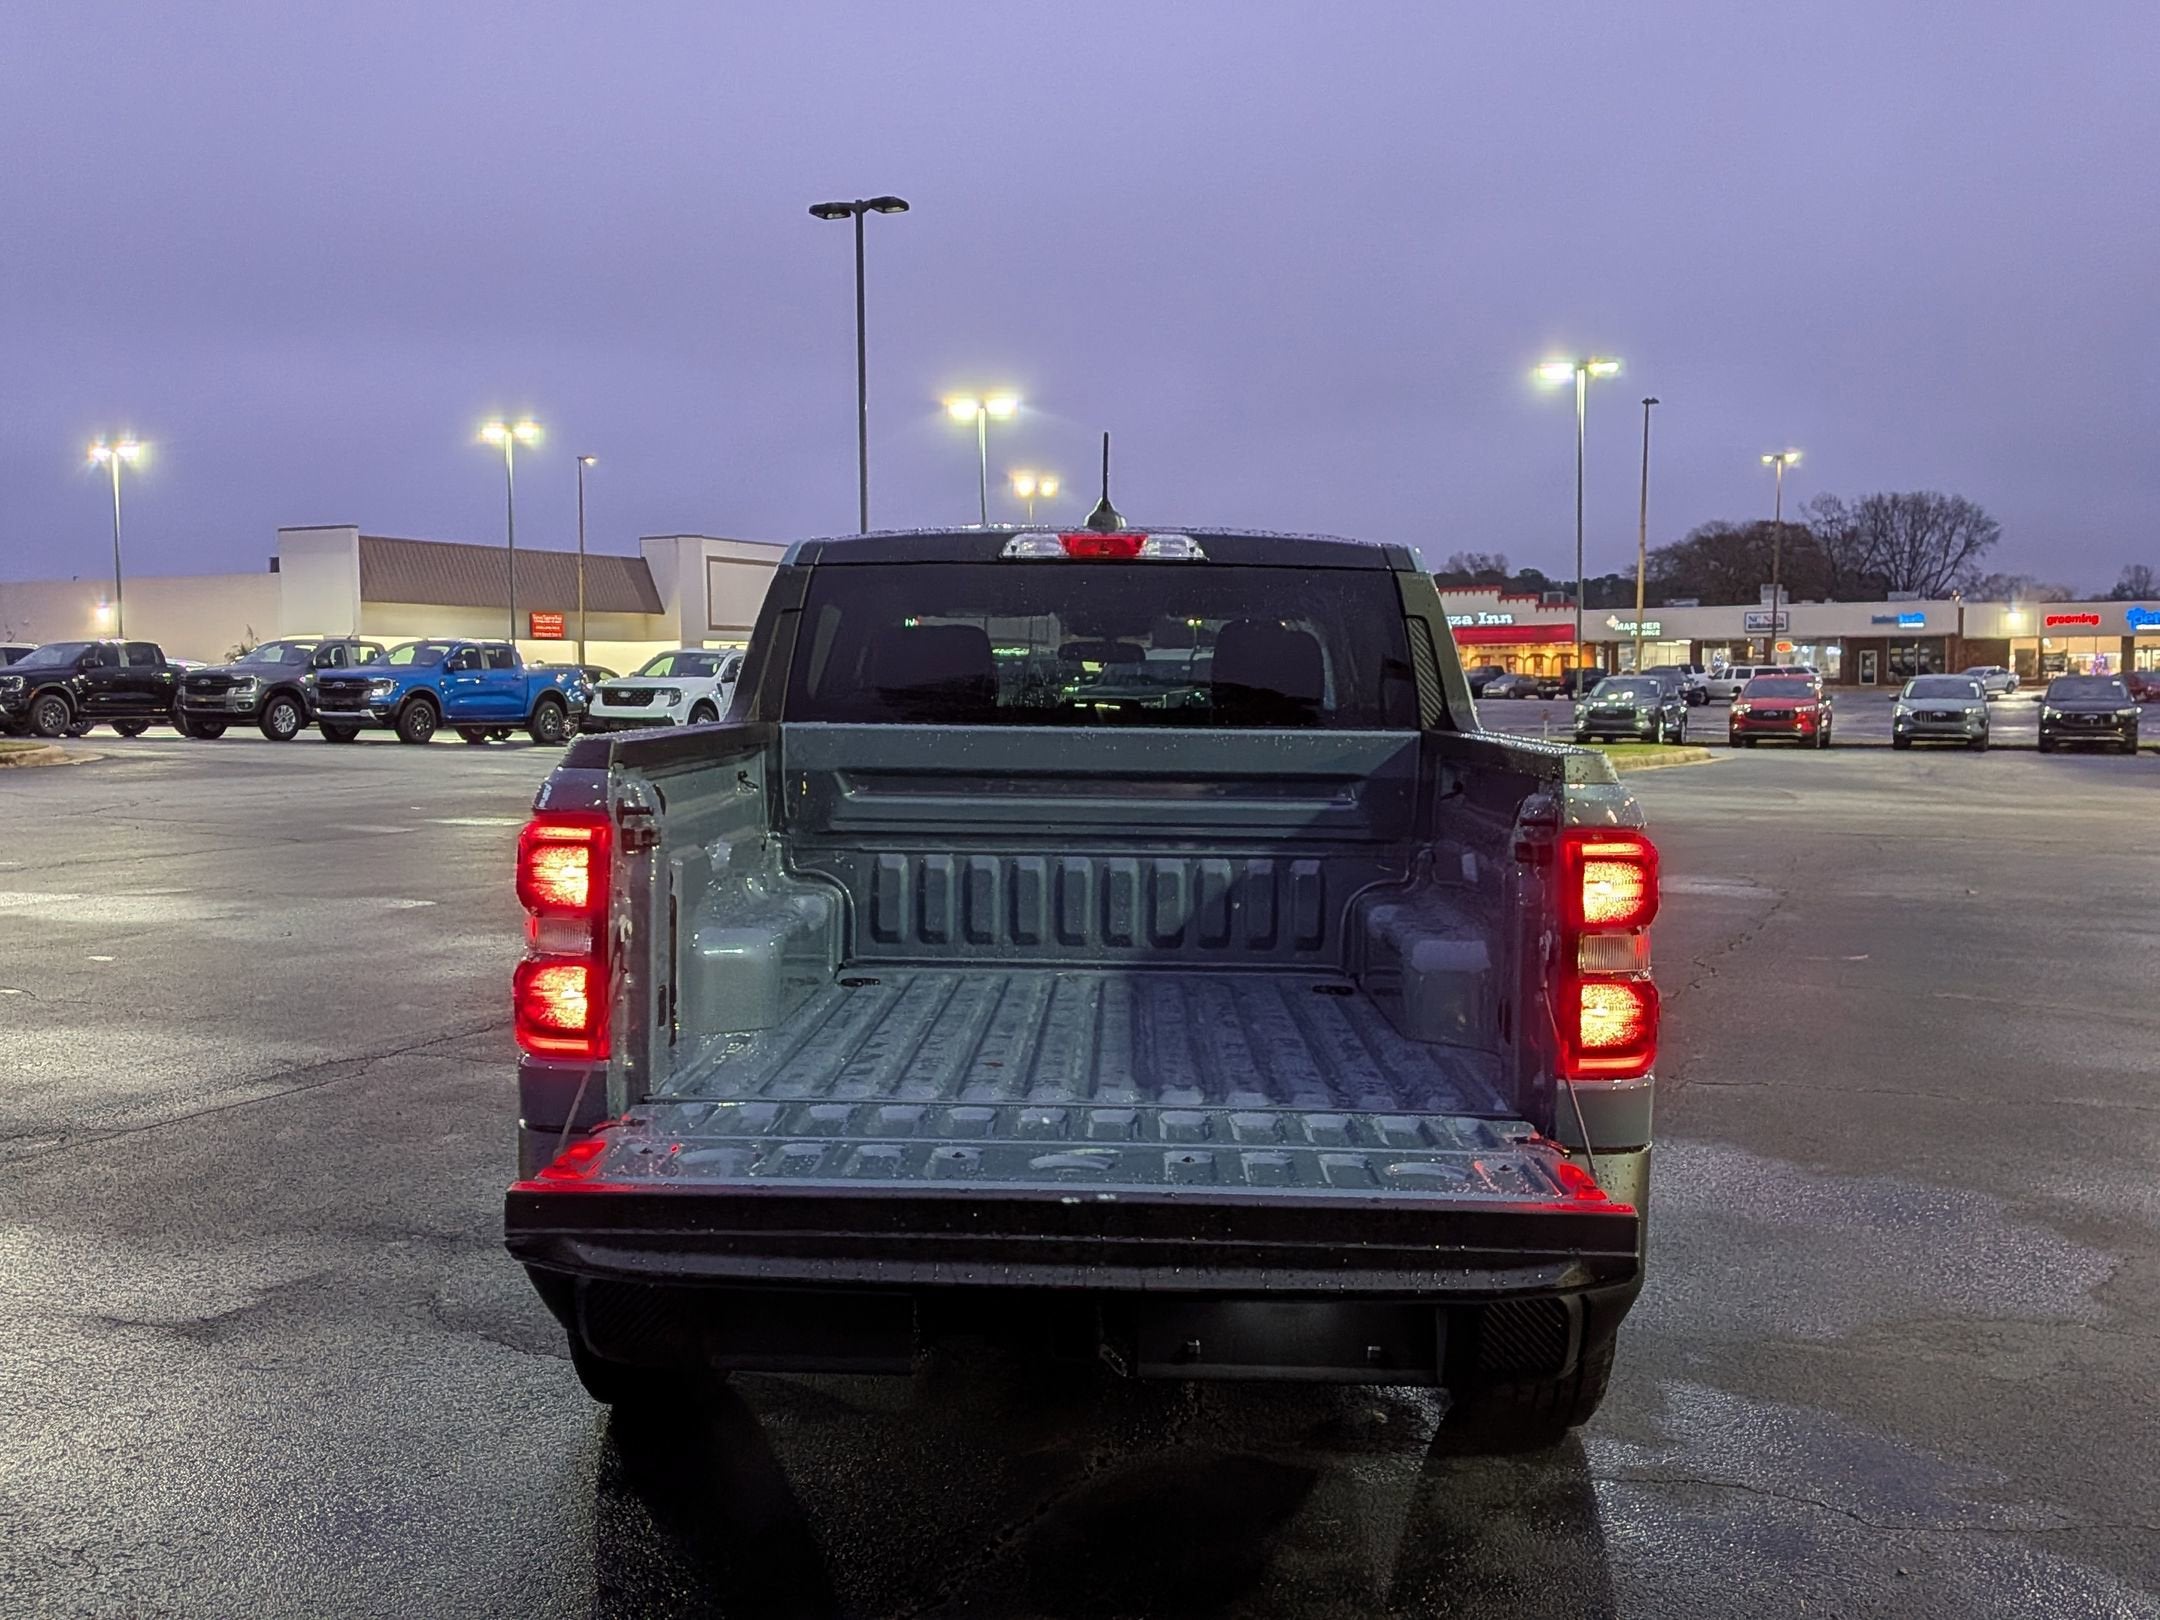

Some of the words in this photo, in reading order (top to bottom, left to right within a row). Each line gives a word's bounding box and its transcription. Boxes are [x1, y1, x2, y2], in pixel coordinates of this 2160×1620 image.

[1475, 611, 1513, 625] Inn
[2045, 613, 2100, 627] grooming
[1614, 621, 1661, 631] MARNER
